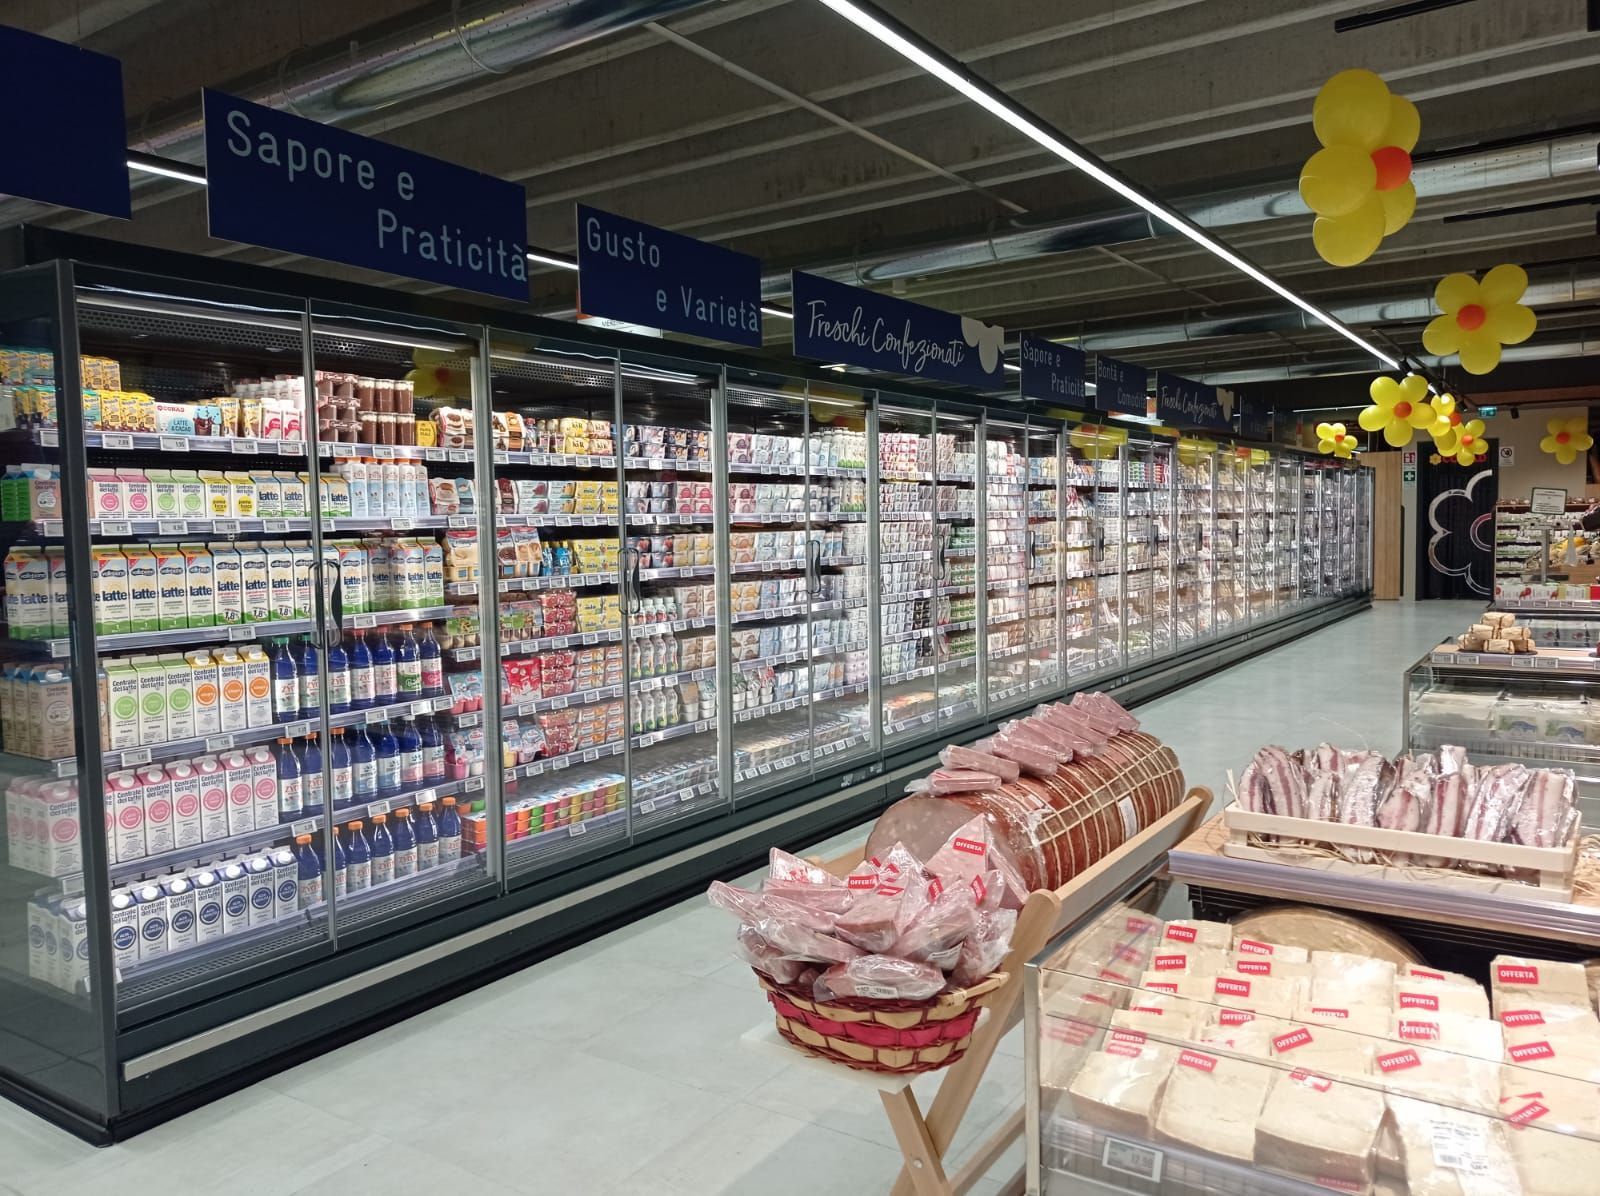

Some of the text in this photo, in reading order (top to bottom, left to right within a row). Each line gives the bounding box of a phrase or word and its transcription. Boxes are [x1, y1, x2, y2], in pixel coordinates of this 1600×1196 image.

[226, 110, 415, 201] Sapore e
[378, 208, 529, 283] Praticità
[586, 217, 661, 268] Gusto
[655, 284, 759, 333] e Varietà
[807, 299, 964, 373] Freschi Confezionati
[1023, 339, 1062, 369] Sapore e
[173, 419, 189, 427] LATTE
[259, 491, 278, 501] latte
[284, 491, 302, 501] latte
[332, 493, 348, 502] latte
[217, 580, 240, 592] latte
[245, 579, 267, 591] latte
[271, 578, 292, 589] latte
[344, 576, 361, 586] latte
[132, 588, 156, 600] latte
[161, 587, 184, 598] latte
[190, 585, 212, 597] latte
[102, 591, 127, 602] latte
[167, 672, 190, 681] Centrale
[194, 668, 216, 676] Centrale
[112, 679, 137, 688] Centrale
[140, 676, 165, 684] Centrale
[167, 678, 176, 686] del
[112, 685, 122, 693] del
[140, 682, 149, 690] del
[201, 773, 224, 782] Centrale
[146, 784, 170, 793] Centrale
[174, 779, 198, 788] Centrale
[147, 789, 170, 799] del latte
[175, 785, 184, 793] del
[117, 790, 141, 799] Centrale
[118, 795, 141, 804] del latte
[954, 841, 984, 852] OFFERTA
[850, 877, 878, 885] OFFERTA
[170, 893, 193, 903] Centrale
[180, 898, 193, 906] latte
[140, 901, 165, 911] Centrale
[151, 906, 165, 915] latte
[1168, 929, 1194, 938] OFFERTA
[1241, 944, 1270, 955] OFFERTA
[1156, 957, 1184, 966] OFFERTA
[1238, 963, 1268, 971] OFFERTA
[1500, 970, 1535, 979] OFFERTA
[1217, 981, 1248, 993] OFFERTA
[1401, 997, 1435, 1006] OFFERTA
[1222, 1012, 1252, 1021] OFFERTA
[1505, 1013, 1541, 1022] OFFERTA
[1401, 1025, 1437, 1035] OFFERTA
[1113, 1033, 1143, 1043] OFFERTA
[1275, 1032, 1309, 1048] OFFERTA
[1512, 1045, 1549, 1057] OFFERTA
[1182, 1054, 1213, 1068] OFFERTA
[1381, 1054, 1416, 1067] OFFERTA
